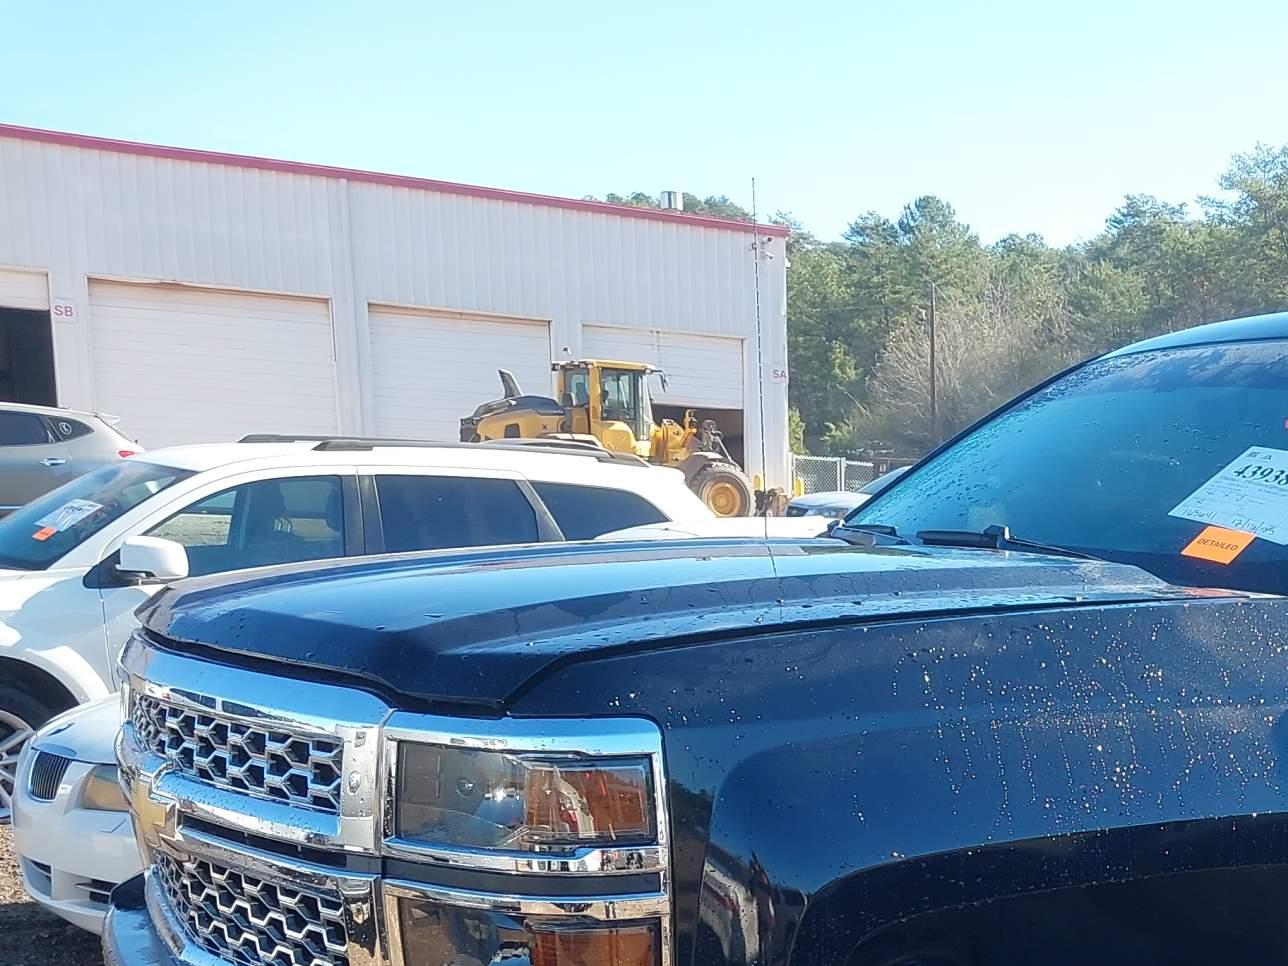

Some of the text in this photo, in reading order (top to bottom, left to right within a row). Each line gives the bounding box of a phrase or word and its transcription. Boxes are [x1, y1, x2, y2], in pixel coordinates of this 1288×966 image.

[54, 305, 74, 317] SB
[772, 369, 787, 379] SA
[1197, 537, 1239, 551] DETAILED
